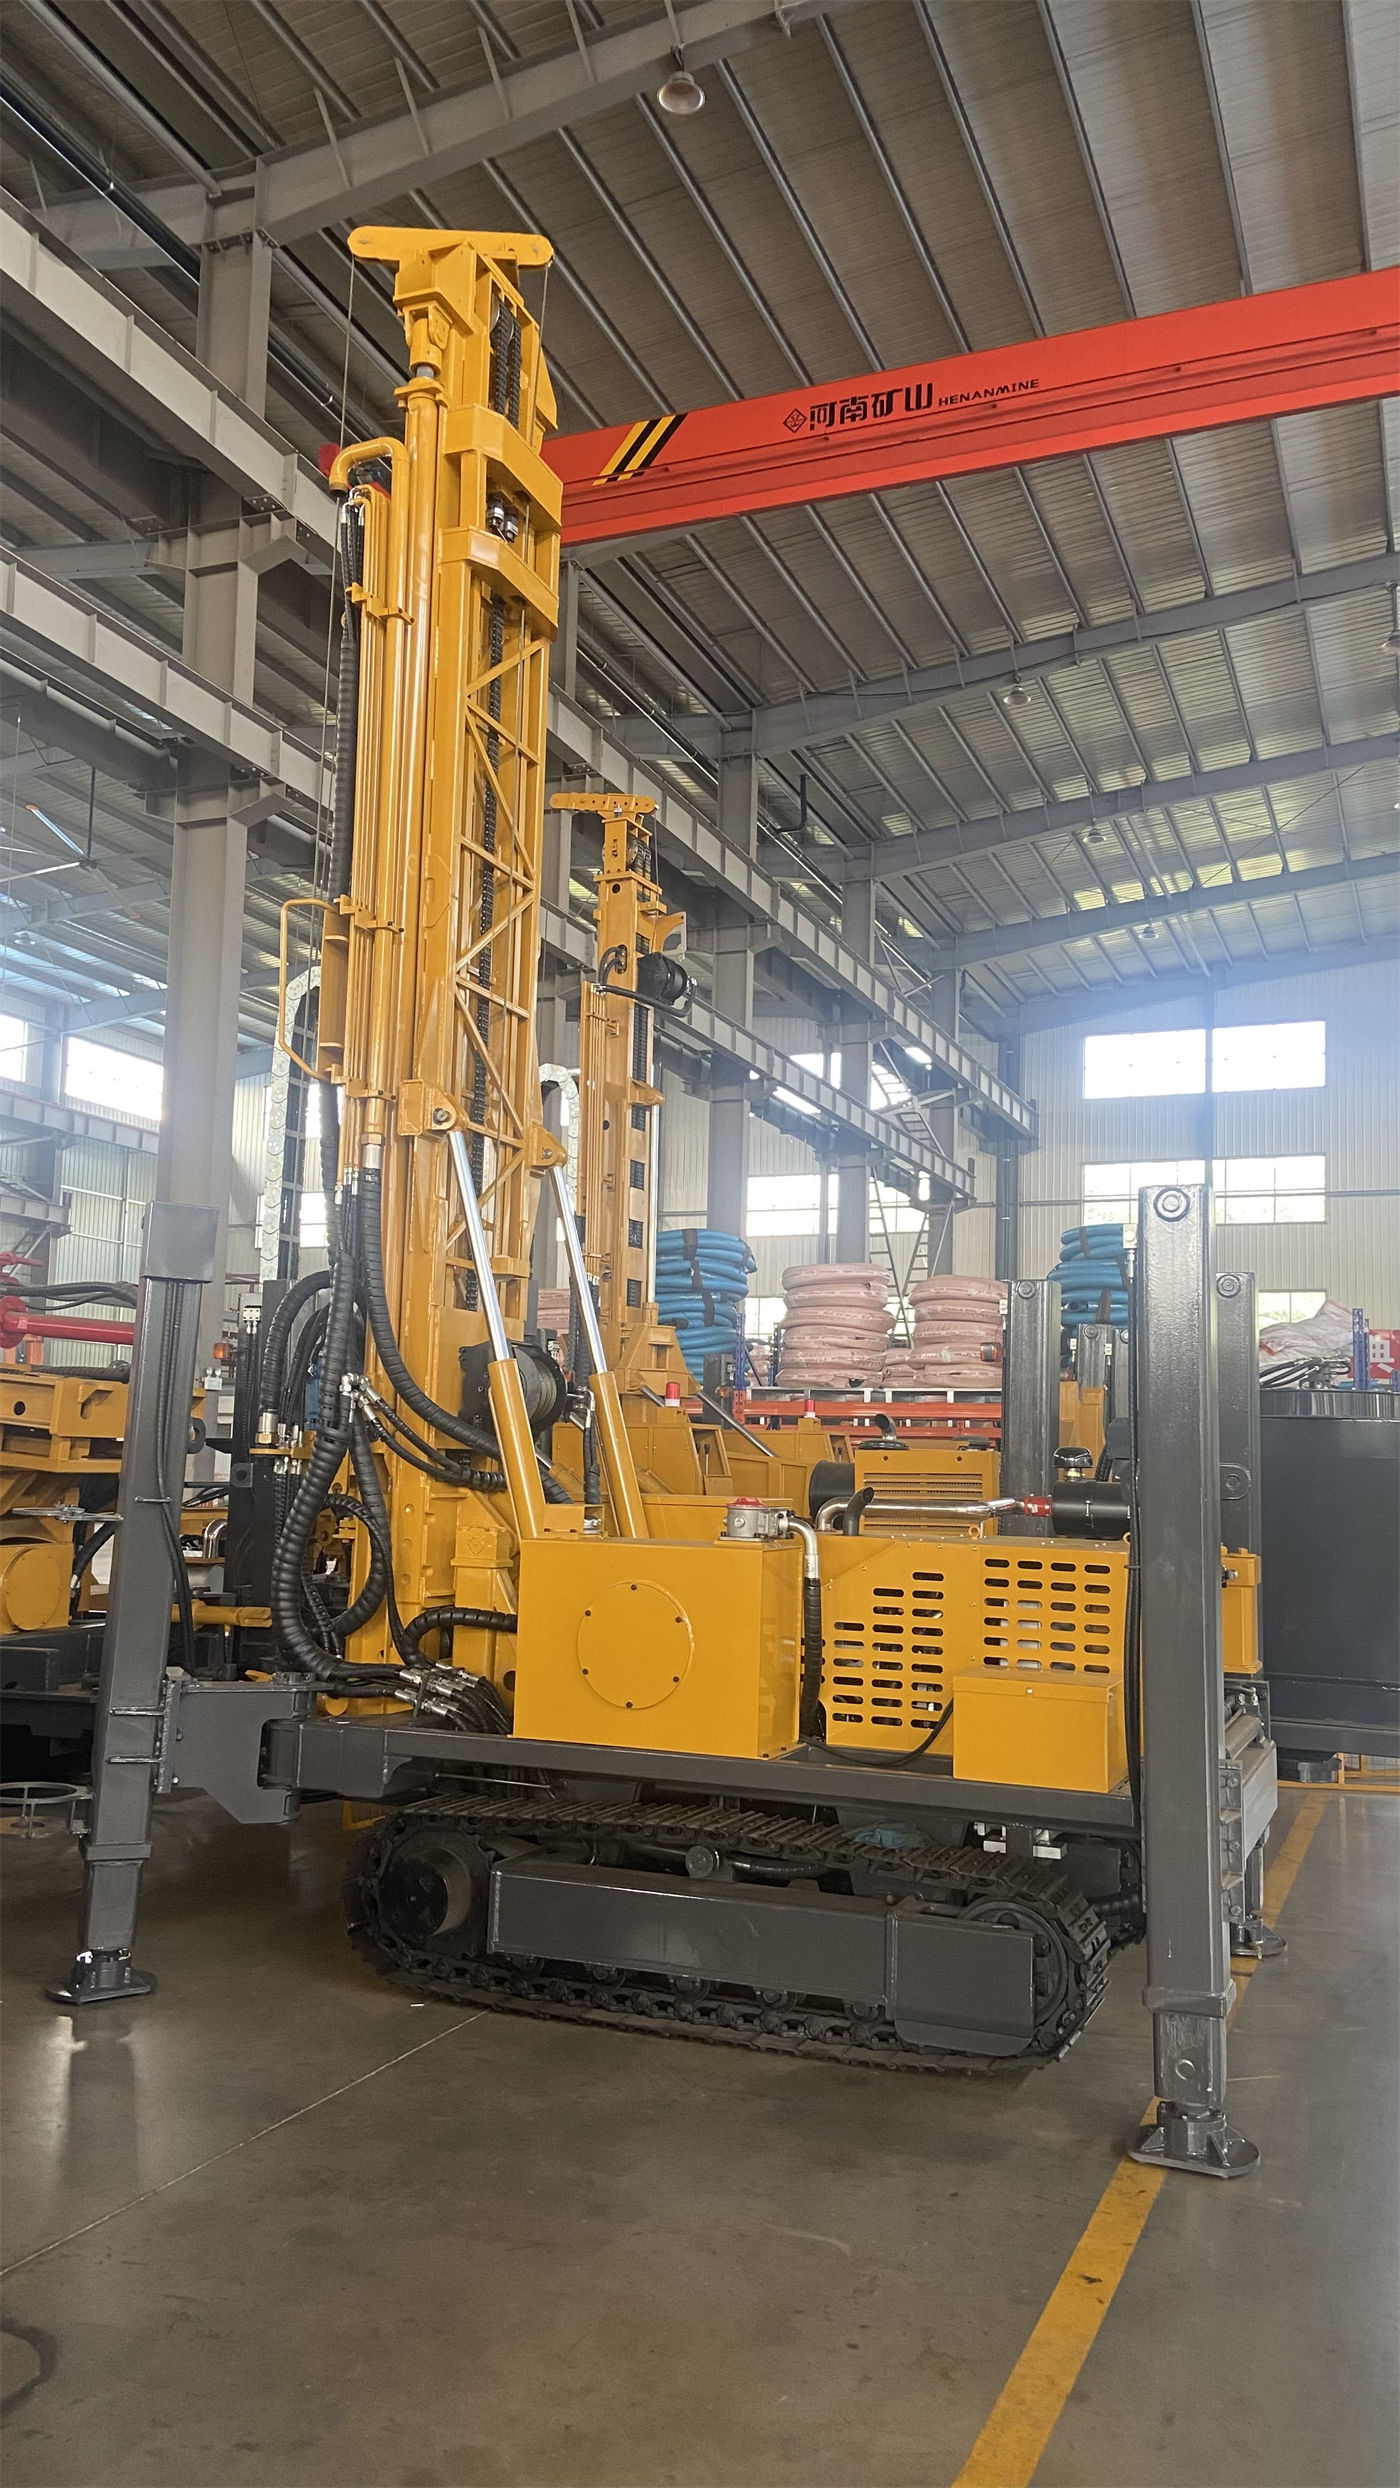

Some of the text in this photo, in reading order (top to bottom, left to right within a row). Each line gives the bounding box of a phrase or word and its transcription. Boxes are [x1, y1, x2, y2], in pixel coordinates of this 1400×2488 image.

[809, 382, 933, 431] 河南矿山
[938, 378, 1040, 407] HENANMINE
